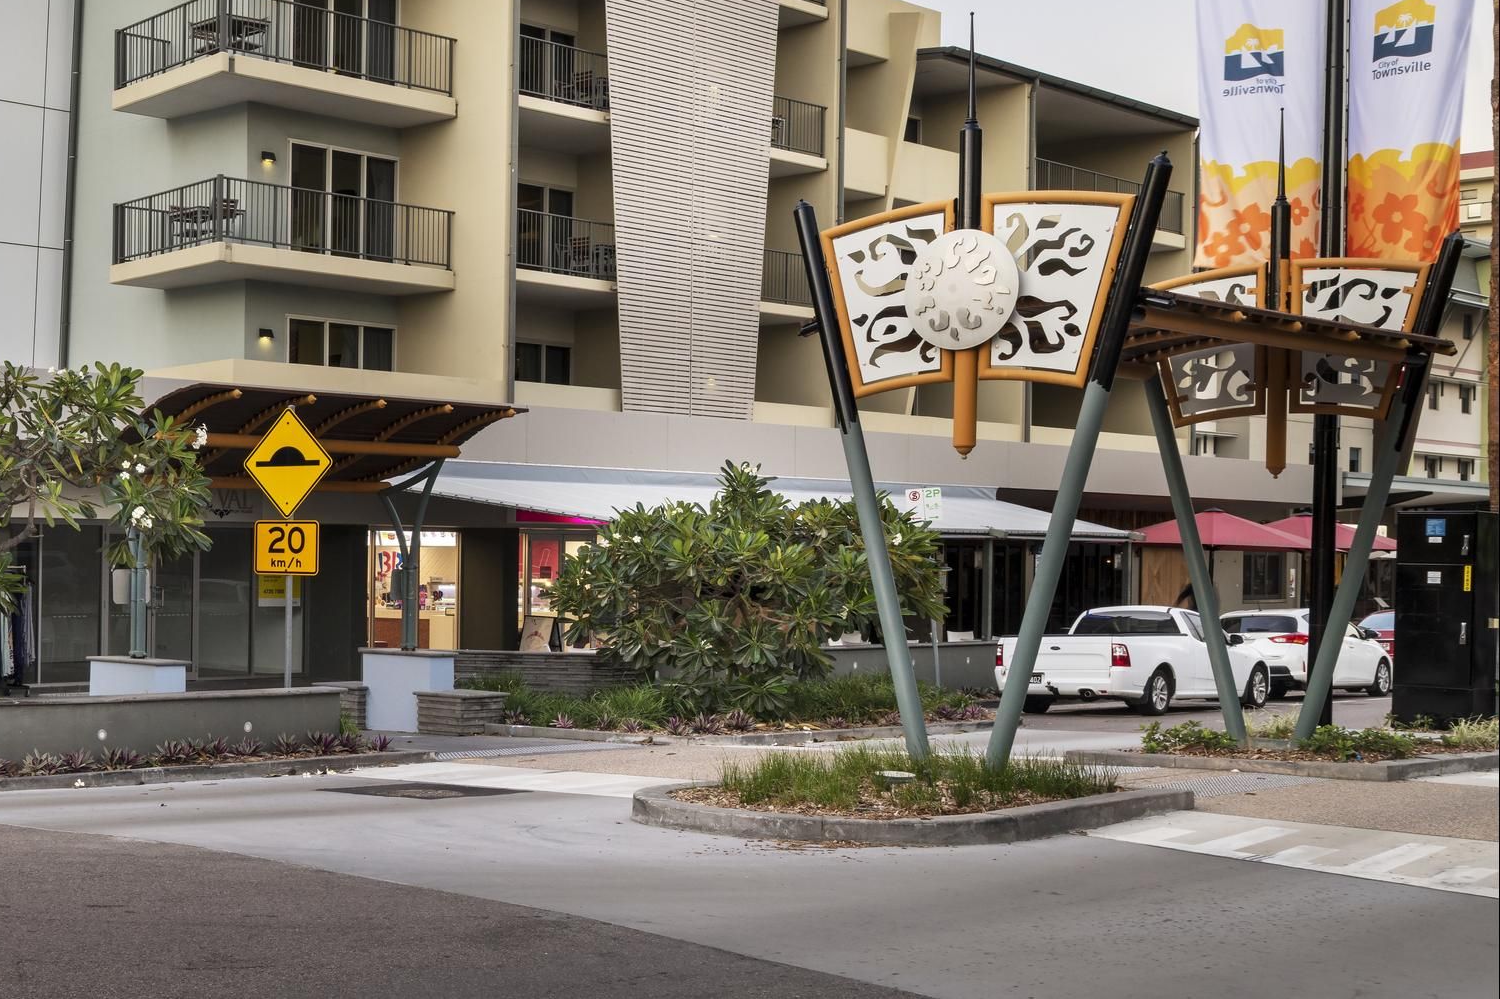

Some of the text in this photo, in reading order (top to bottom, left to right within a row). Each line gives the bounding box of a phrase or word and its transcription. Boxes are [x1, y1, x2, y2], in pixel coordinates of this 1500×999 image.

[1372, 61, 1431, 80] Townsville
[1378, 61, 1390, 69] City
[925, 489, 940, 498] 2P
[268, 526, 305, 554] 20
[270, 557, 302, 569] km/h
